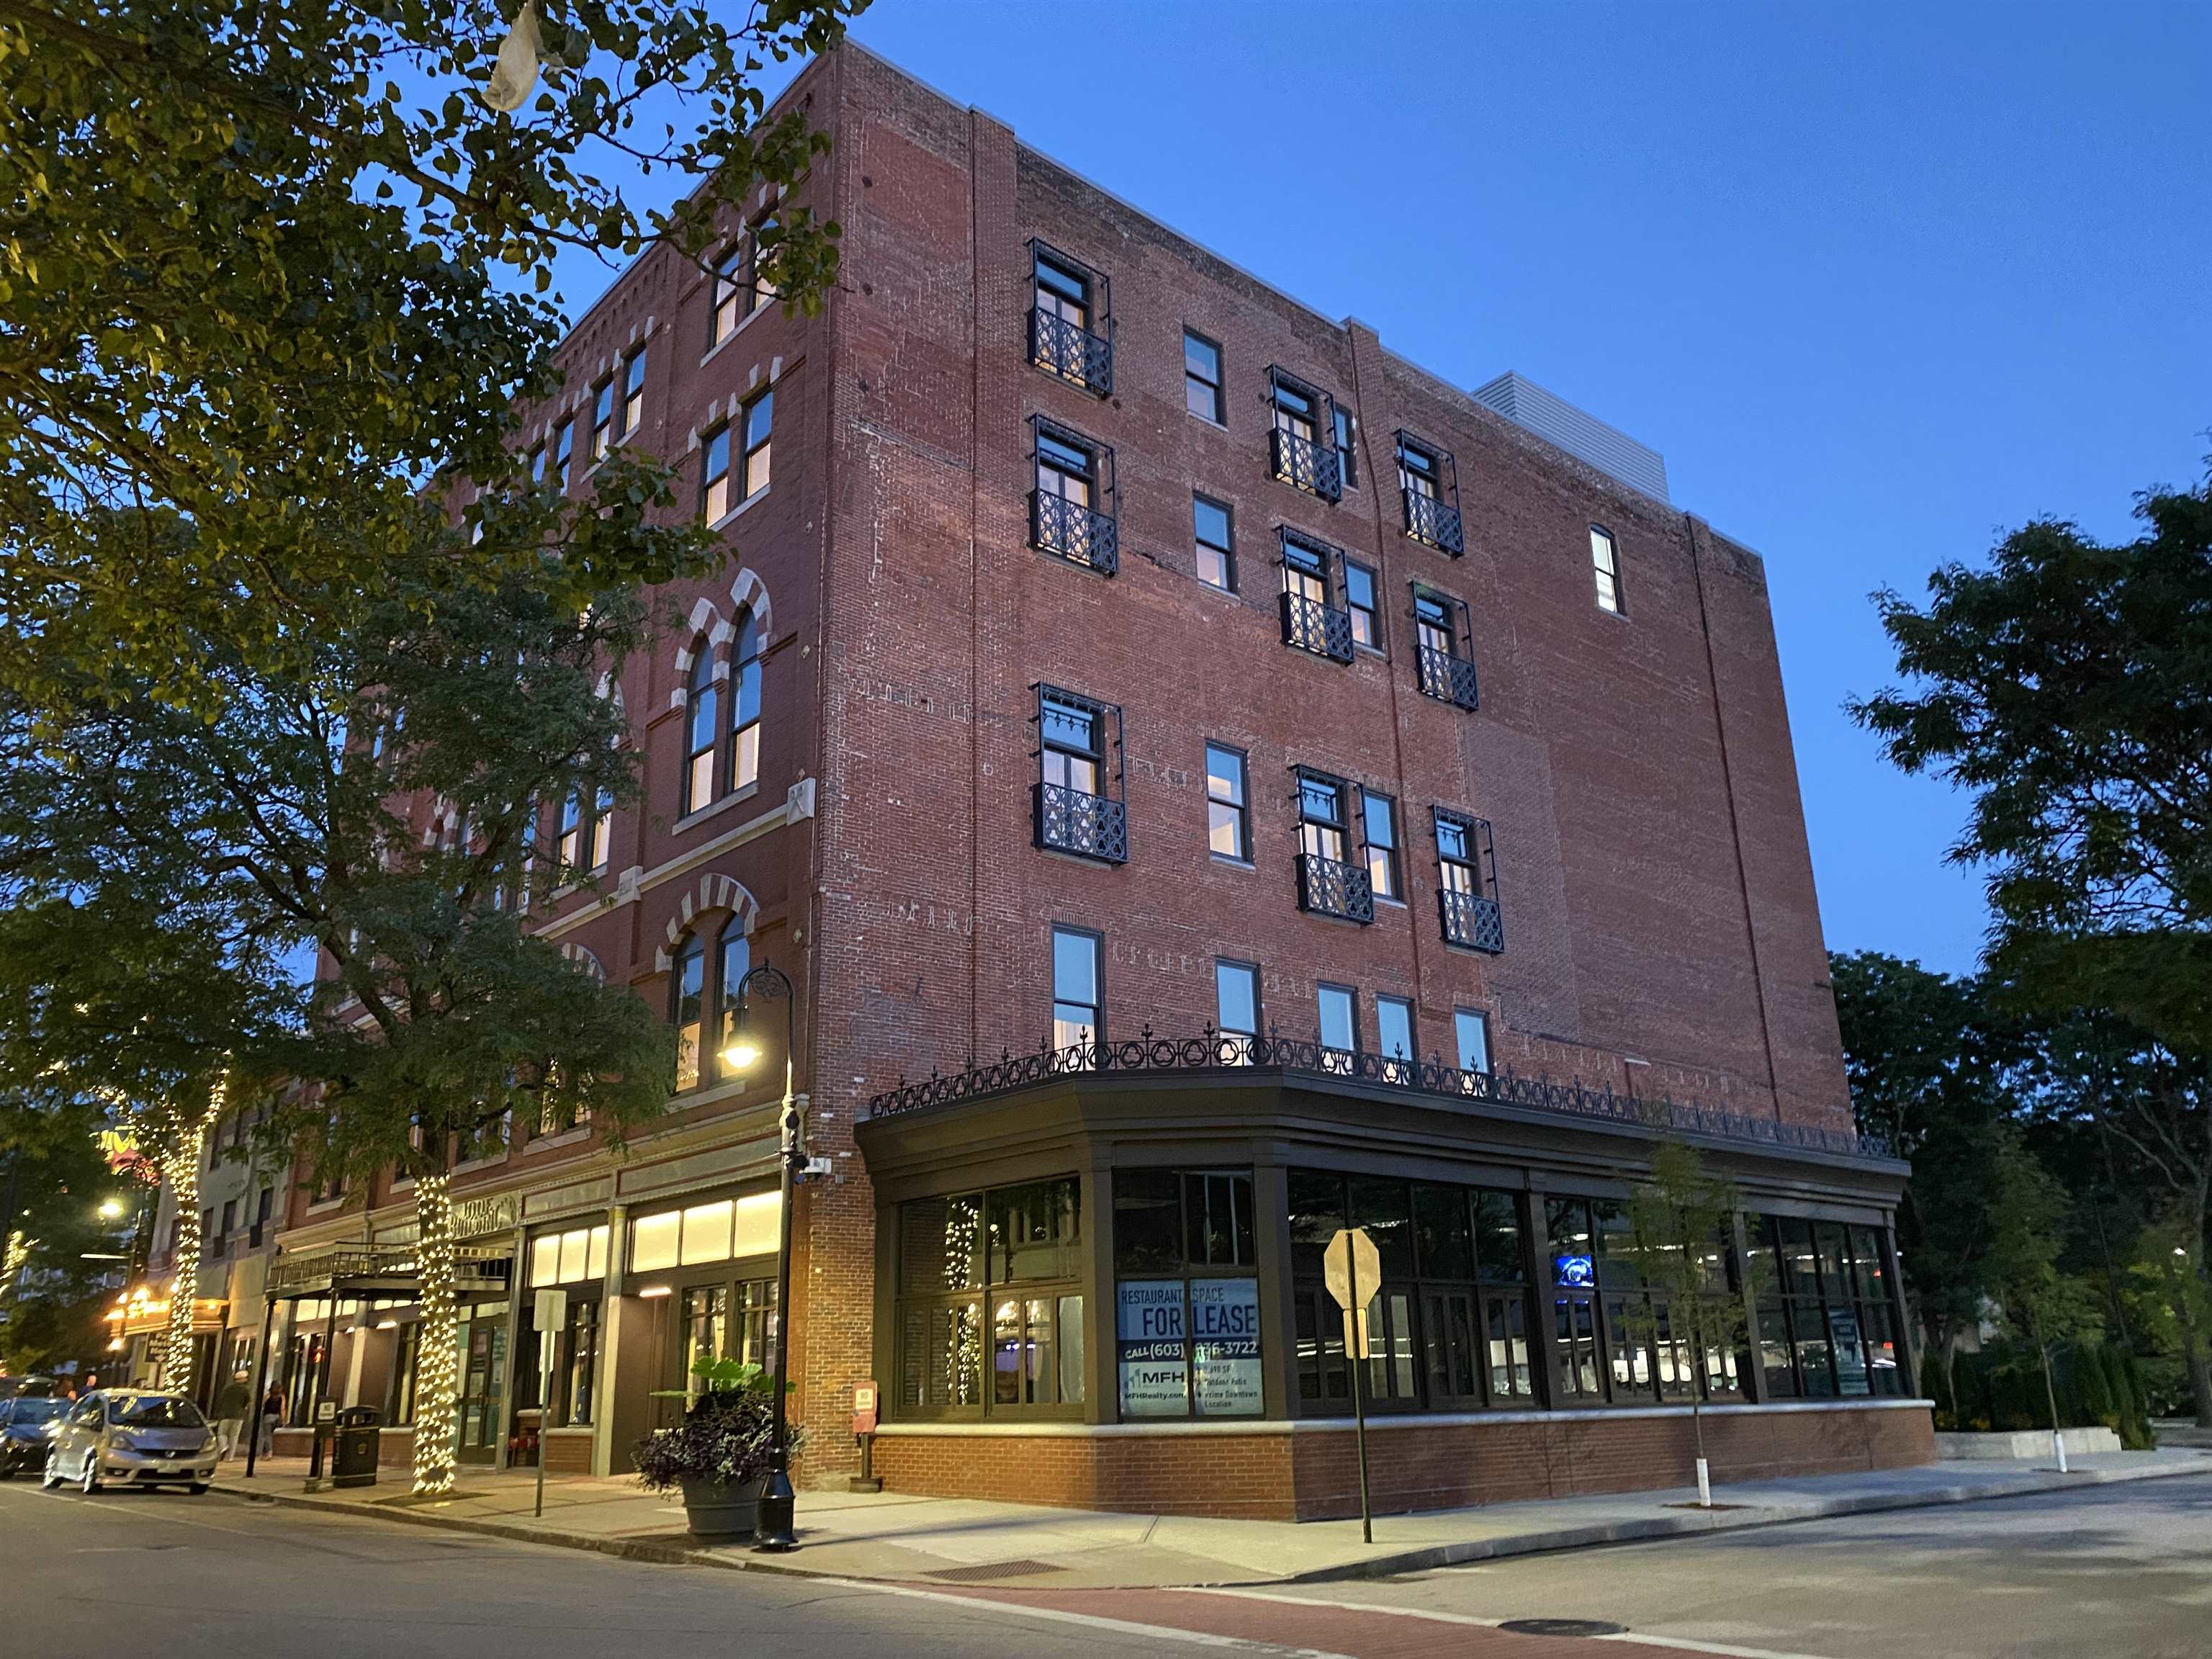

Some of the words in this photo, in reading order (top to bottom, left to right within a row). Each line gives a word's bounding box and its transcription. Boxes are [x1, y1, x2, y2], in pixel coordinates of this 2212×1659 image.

[449, 1204, 503, 1241] BUILDING
[1120, 1288, 1183, 1305] RESTAURANT
[1192, 1287, 1225, 1303] SPACE
[1142, 1307, 1183, 1336] FOR
[1192, 1304, 1257, 1335] LEASE
[1125, 1346, 1149, 1359] CALL
[1150, 1343, 1185, 1360] (603)
[1142, 1371, 1185, 1383] MFH
